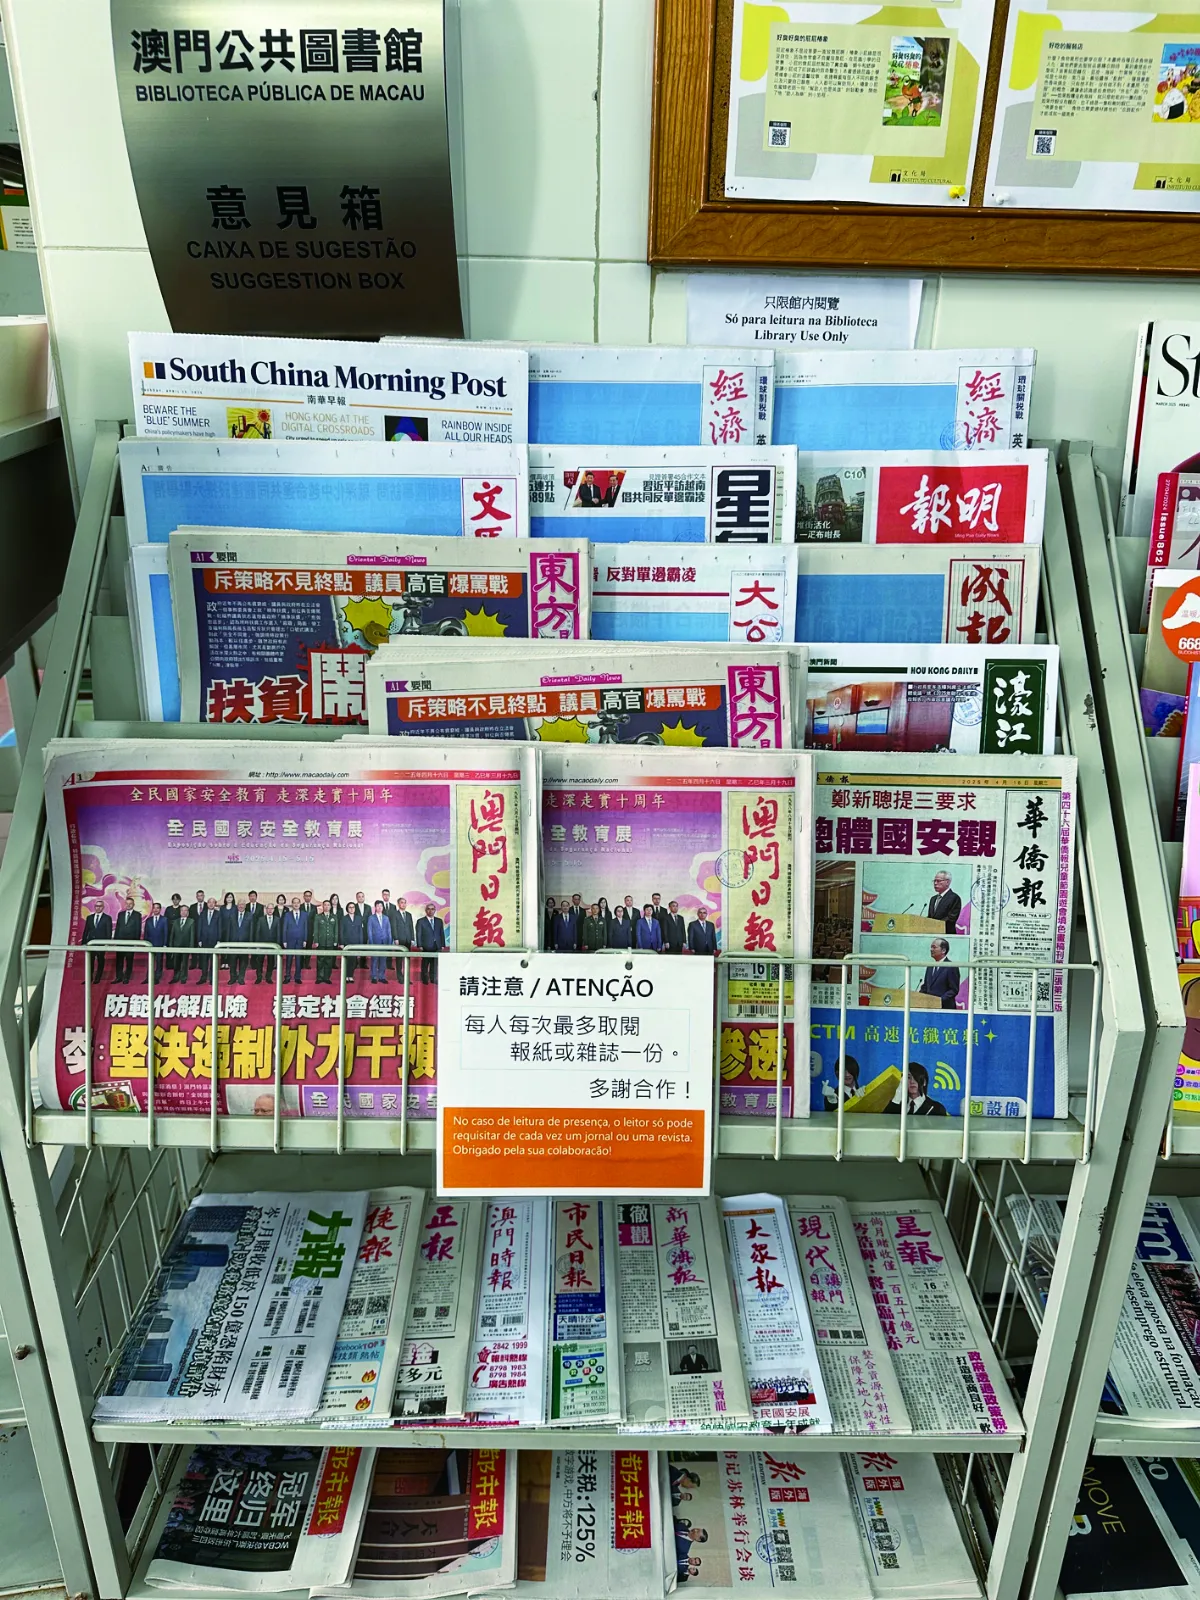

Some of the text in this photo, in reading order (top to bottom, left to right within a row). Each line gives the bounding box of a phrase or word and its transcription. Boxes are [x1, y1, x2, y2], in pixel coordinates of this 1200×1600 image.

[131, 28, 423, 74] 澳門公共圖書館
[135, 82, 425, 102] BIBLIOTECA PÚBLICA DE MACAU
[206, 184, 384, 231] 意見箱
[186, 237, 417, 259] CAIXA DE SUGESTÃO
[210, 272, 405, 290] SUGGESTION BOX
[764, 296, 840, 311] 只限館內閱覽
[725, 313, 878, 327] Só para leitura na Biblioteca
[754, 329, 849, 344] Library Use Only
[169, 357, 508, 401] South China Morning Post
[143, 404, 197, 416] BEWARE THE
[307, 394, 346, 406] 南華早報
[965, 370, 1006, 450] 經濟
[172, 416, 211, 428] SUMMER
[285, 412, 370, 425] HONG KONG AT THE
[442, 420, 512, 433] RAINBOW INSIDE
[281, 422, 375, 436] DIGITAL CROSSROADS
[445, 431, 513, 444] ALL OUR HEADS
[643, 480, 706, 492] 習近平訪越南
[621, 491, 706, 503] 倡共同反單邊霸凌
[1155, 512, 1169, 563] Issue 862
[216, 552, 238, 563] 要聞
[348, 555, 426, 565] Oriental Daily News
[214, 571, 352, 594] 斥策略不見終點
[606, 566, 697, 583] 反對單邊霸凌
[733, 579, 779, 643] 大公
[809, 658, 838, 666] 澳門新聞
[911, 667, 973, 675] HOU KONG DAILY
[410, 679, 432, 691] 要聞
[541, 674, 621, 685] Oriental Daily News
[407, 694, 547, 719] 斥策略不見終點
[993, 670, 1034, 754] 濠江
[130, 786, 394, 803] 全民國家安全教育 走深走實十周年
[545, 792, 665, 809] 走深走實十周年
[831, 789, 977, 811] 鄭新聰提三要求
[166, 819, 364, 839] 全民國家安全教育展
[1013, 795, 1049, 909] 華僑報
[470, 789, 508, 947] 澳門日報
[743, 796, 781, 952] 澳門日報
[459, 975, 653, 1002] 請注意 ATENÇÃO
[1010, 987, 1020, 996] 16
[104, 994, 248, 1019] 防範化解風險
[465, 1014, 640, 1037] 每人每次最多取閱
[810, 1024, 856, 1040] CTM
[864, 1024, 980, 1047] 高速光纖寬頻
[510, 1042, 679, 1064] 報紙或雜誌一份。
[589, 1078, 691, 1100] 多謝合作！
[722, 1091, 785, 1109] 教育展
[453, 1116, 693, 1130] No caso de leitura de presença, o leitor só pode
[453, 1131, 693, 1144] requisitar de cada vez um jornal ou uma revista.
[453, 1145, 545, 1157] Obrigado pela sua
[359, 1206, 399, 1264] 捷報
[421, 1205, 459, 1262] 正報
[487, 1206, 518, 1292] 澳門時報
[562, 1202, 594, 1288] 市民日報
[661, 1206, 705, 1285] 新華澳報
[923, 1281, 937, 1290] 16
[493, 1341, 528, 1350] 2842 1999
[1154, 1349, 1192, 1411] estrutural
[712, 1380, 727, 1412] 夏寶龍
[199, 1468, 239, 1524] 这里
[234, 1470, 277, 1527] 终归
[270, 1470, 309, 1529] 冠军
[619, 1453, 645, 1541] 都市報
[768, 1487, 811, 1503] 海外版
[1081, 1466, 1126, 1535] MOVE
